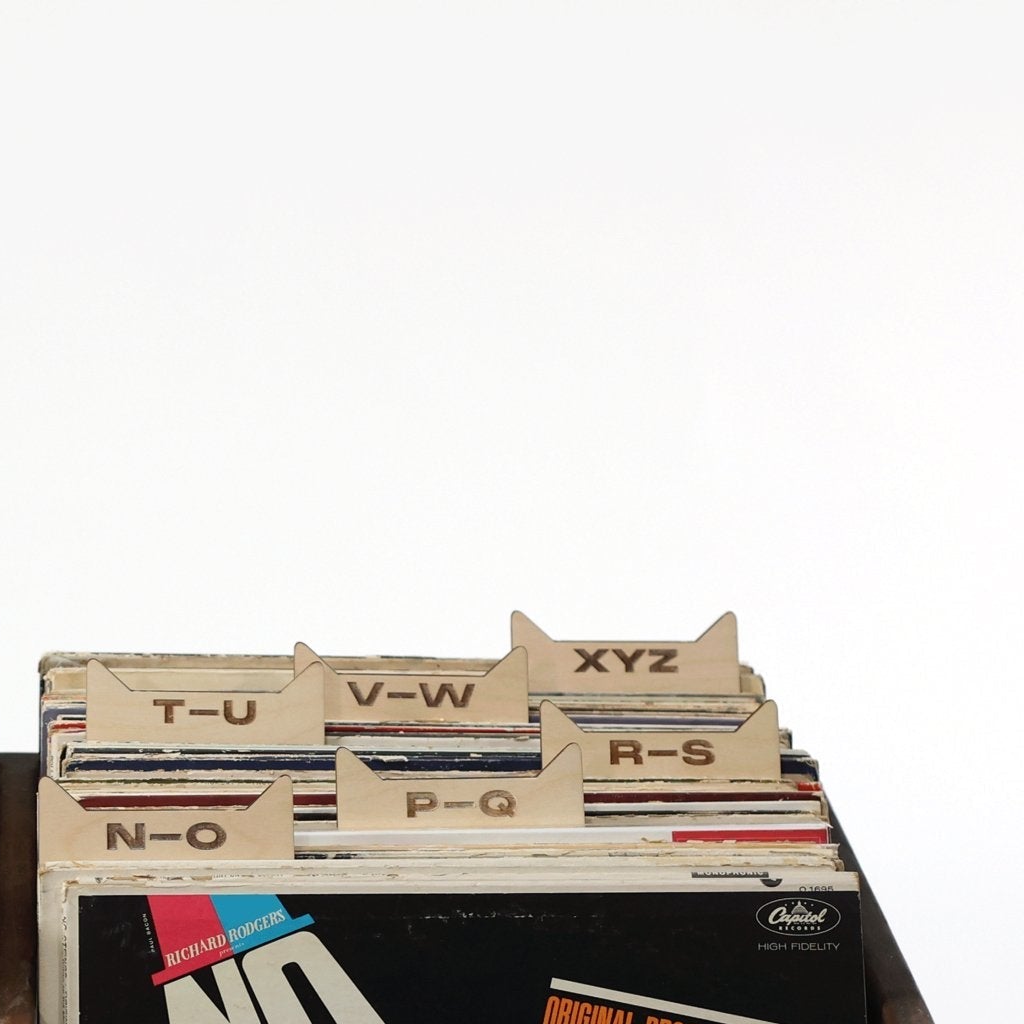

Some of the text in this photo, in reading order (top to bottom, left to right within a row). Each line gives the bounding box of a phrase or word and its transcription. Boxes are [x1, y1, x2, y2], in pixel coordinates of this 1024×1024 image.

[573, 648, 679, 673] XYZ
[142, 913, 151, 935] BACON
[768, 907, 828, 926] Capitol
[166, 908, 285, 967] RICHARD RODGERS
[791, 942, 840, 950] FIDELITY
